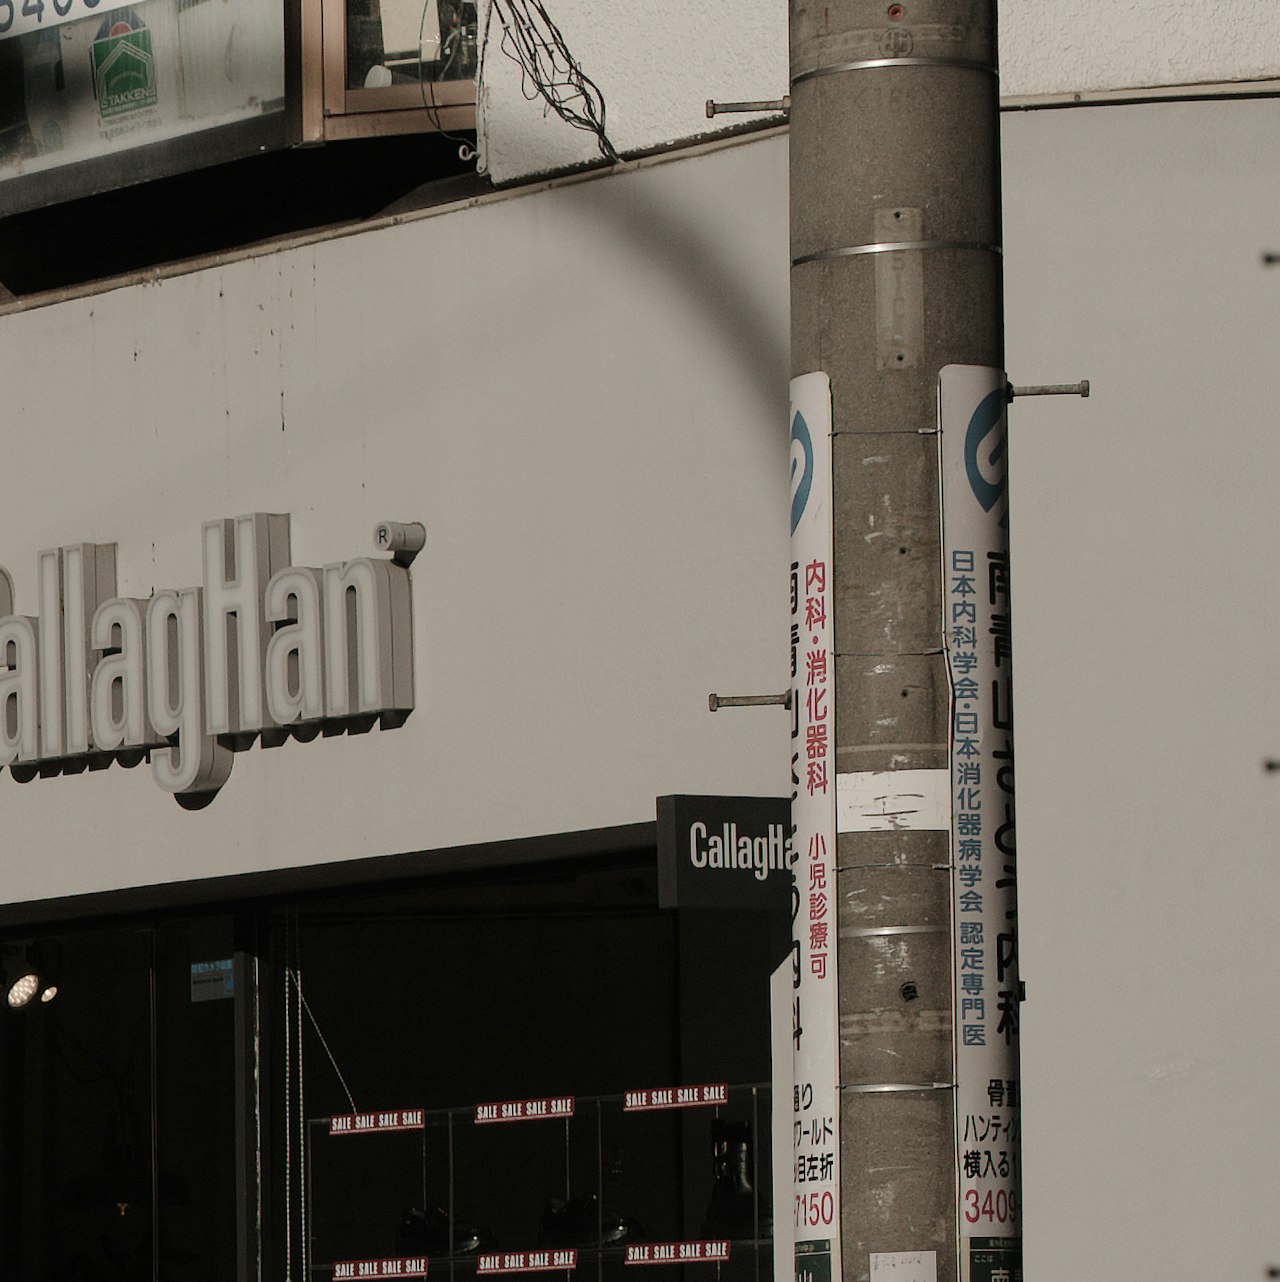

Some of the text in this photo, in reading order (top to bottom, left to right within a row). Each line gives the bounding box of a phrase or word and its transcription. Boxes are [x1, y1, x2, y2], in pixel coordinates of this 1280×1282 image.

[805, 559, 829, 980] 内科・消化器科 小児診療可
[626, 1085, 724, 1106] SALE SALE SALE SALE
[477, 1099, 570, 1118] SALE SALE SALE SALE
[332, 1111, 421, 1130] SALE SALE SALE SALE
[794, 1152, 833, 1184] 目左折
[480, 1251, 573, 1269] SALE SALE SALE SALE
[628, 1242, 726, 1260] SALE SALE SALE SALE
[335, 1258, 424, 1277] SALE SALE SALE SALE
